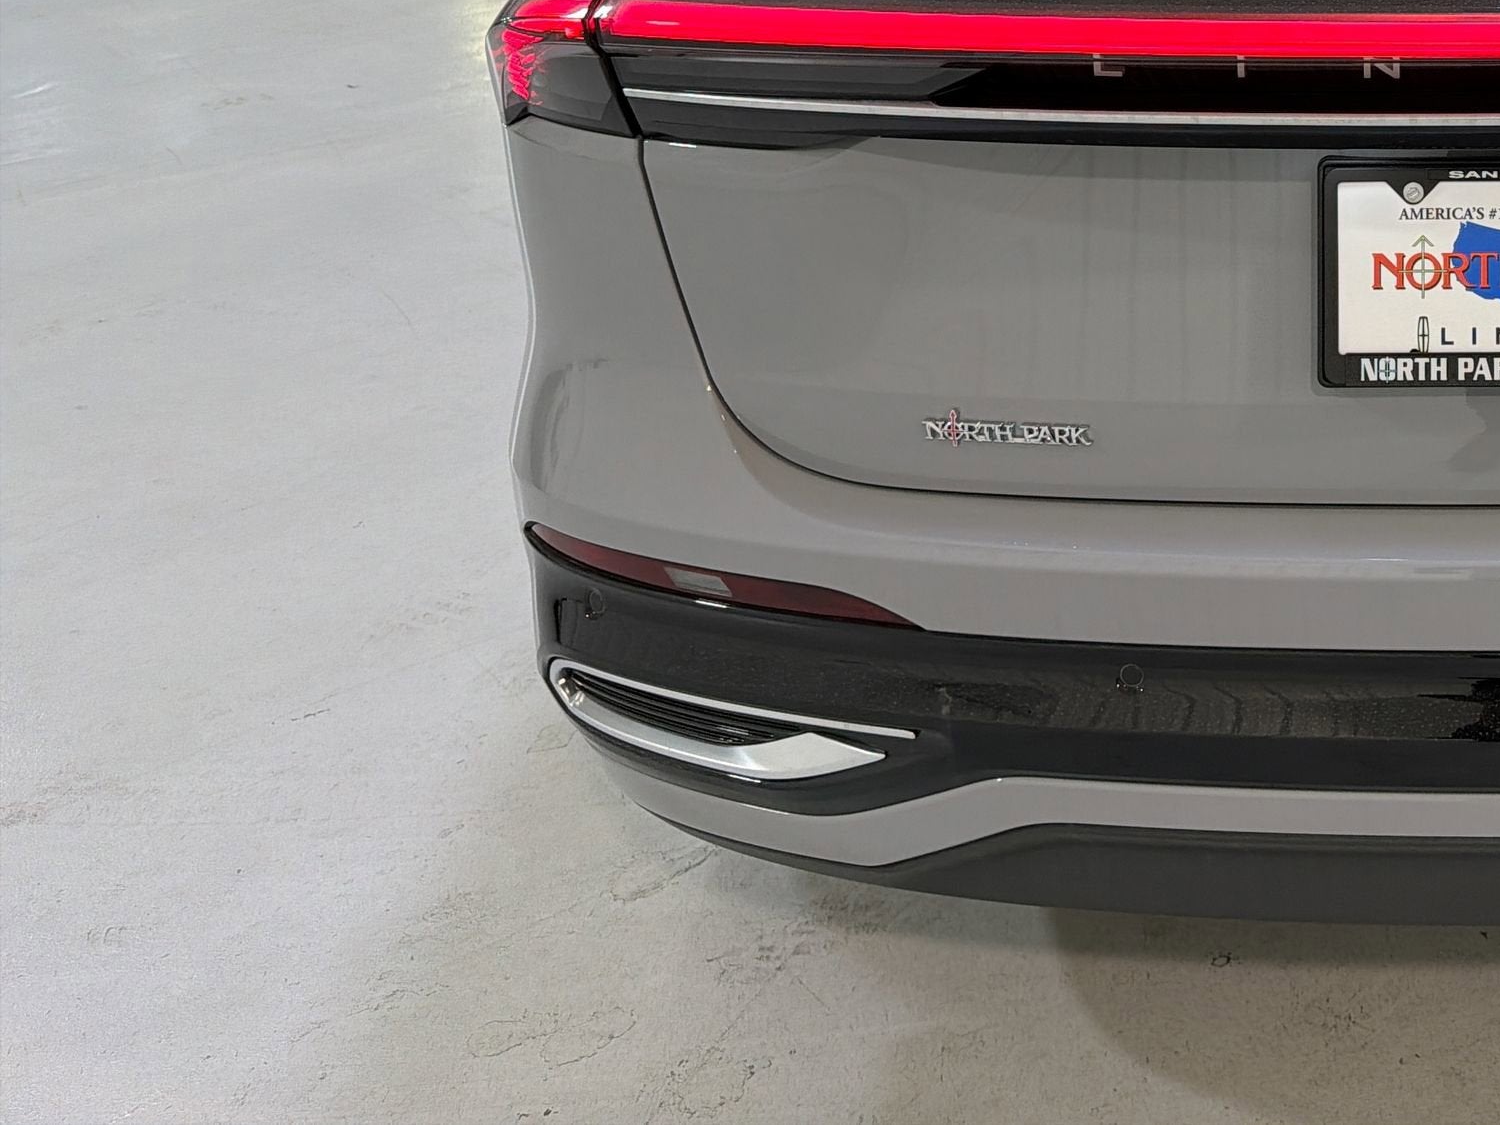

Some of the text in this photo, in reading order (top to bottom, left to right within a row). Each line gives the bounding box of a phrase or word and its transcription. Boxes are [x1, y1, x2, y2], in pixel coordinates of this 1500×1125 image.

[1449, 170, 1498, 179] SAN
[1360, 356, 1448, 383] NORTH
[922, 419, 1092, 446] NORTH PARK
